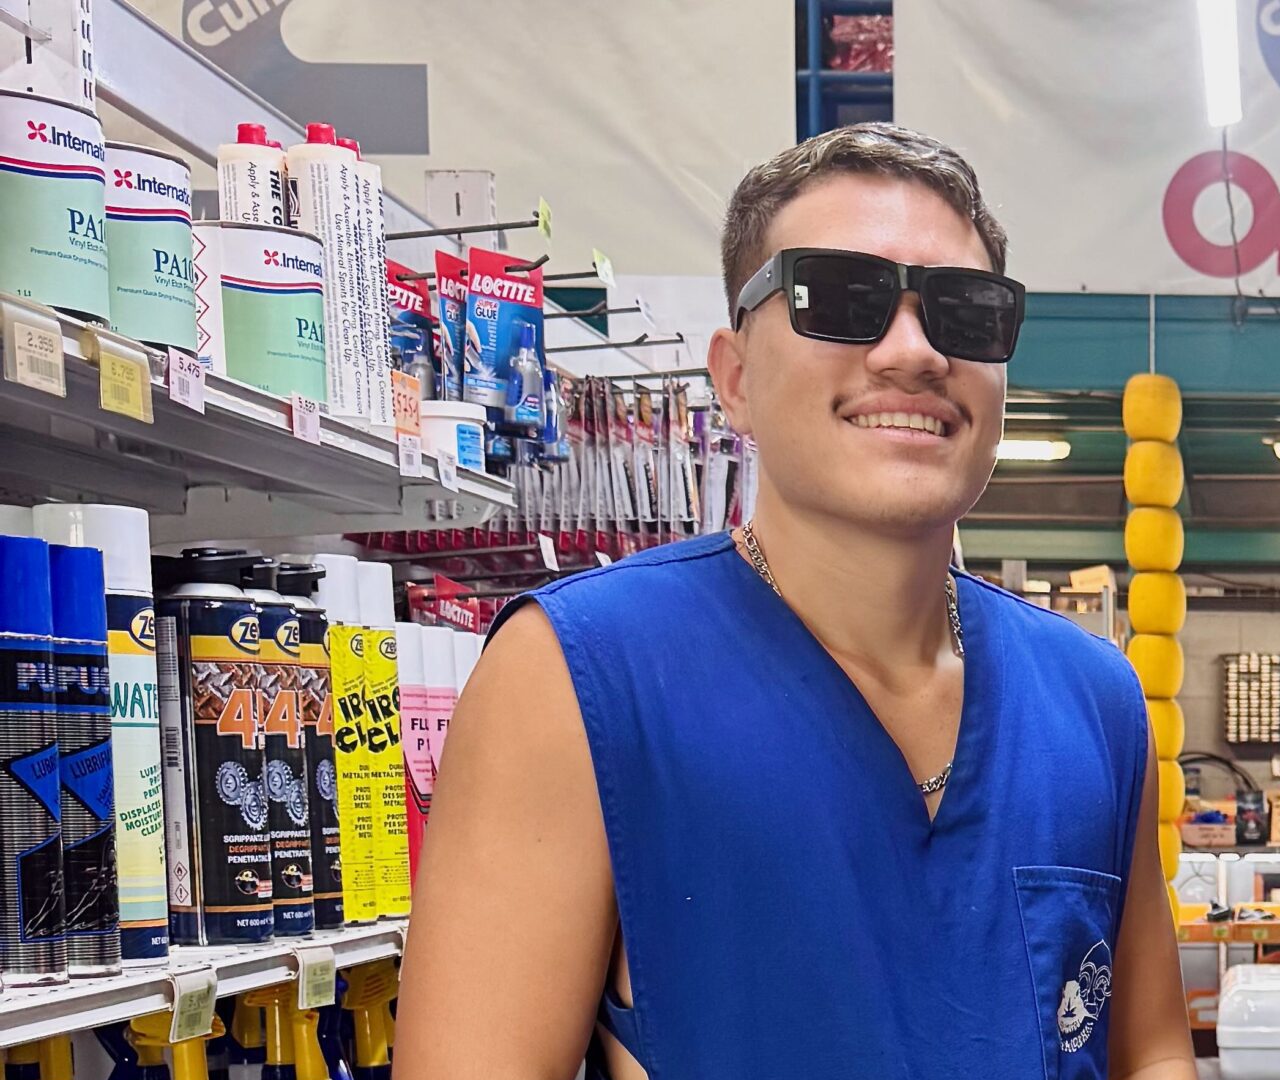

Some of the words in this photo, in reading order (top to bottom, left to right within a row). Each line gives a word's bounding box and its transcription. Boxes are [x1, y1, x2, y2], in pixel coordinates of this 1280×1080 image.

[269, 170, 281, 202] THE
[339, 164, 349, 191] Apply
[335, 213, 343, 230] Use
[470, 273, 536, 304] LOCTITE
[341, 301, 350, 317] For
[475, 307, 499, 320] GLUE
[342, 319, 352, 345] Clean
[178, 357, 200, 379] 5.475
